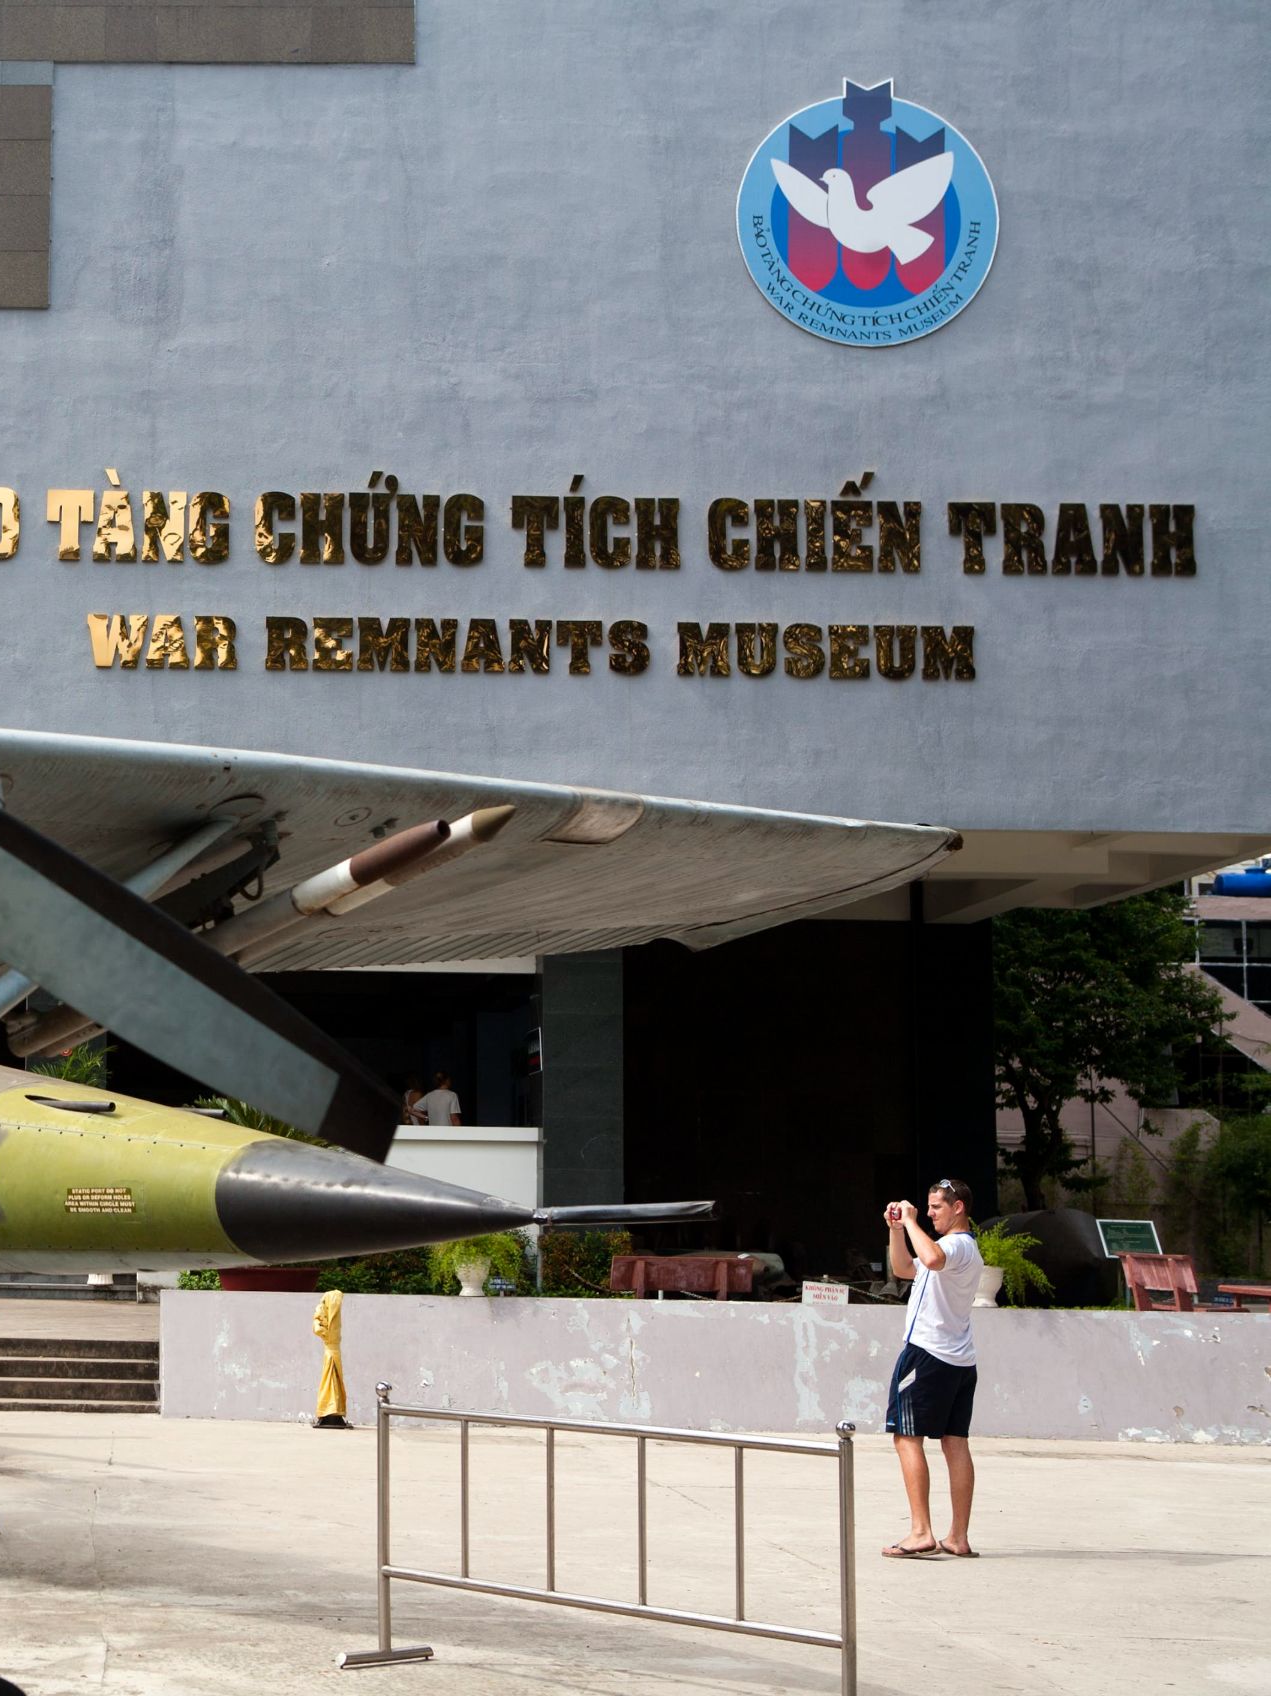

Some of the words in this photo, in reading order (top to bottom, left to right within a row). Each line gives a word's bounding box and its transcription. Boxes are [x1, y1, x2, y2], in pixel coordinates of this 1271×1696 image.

[766, 282, 794, 314] WAR
[798, 312, 892, 340] REMNANTS
[898, 293, 963, 336] MUSEUM
[46, 468, 230, 563] TÀNG
[253, 471, 485, 567] CHỨNG
[511, 473, 680, 570] TÍCH
[707, 471, 922, 574] CHIẾN
[947, 502, 1197, 577] TRANH
[87, 613, 237, 670] WAR
[265, 615, 650, 675] REMNANTS
[676, 620, 976, 681] MUSEUM
